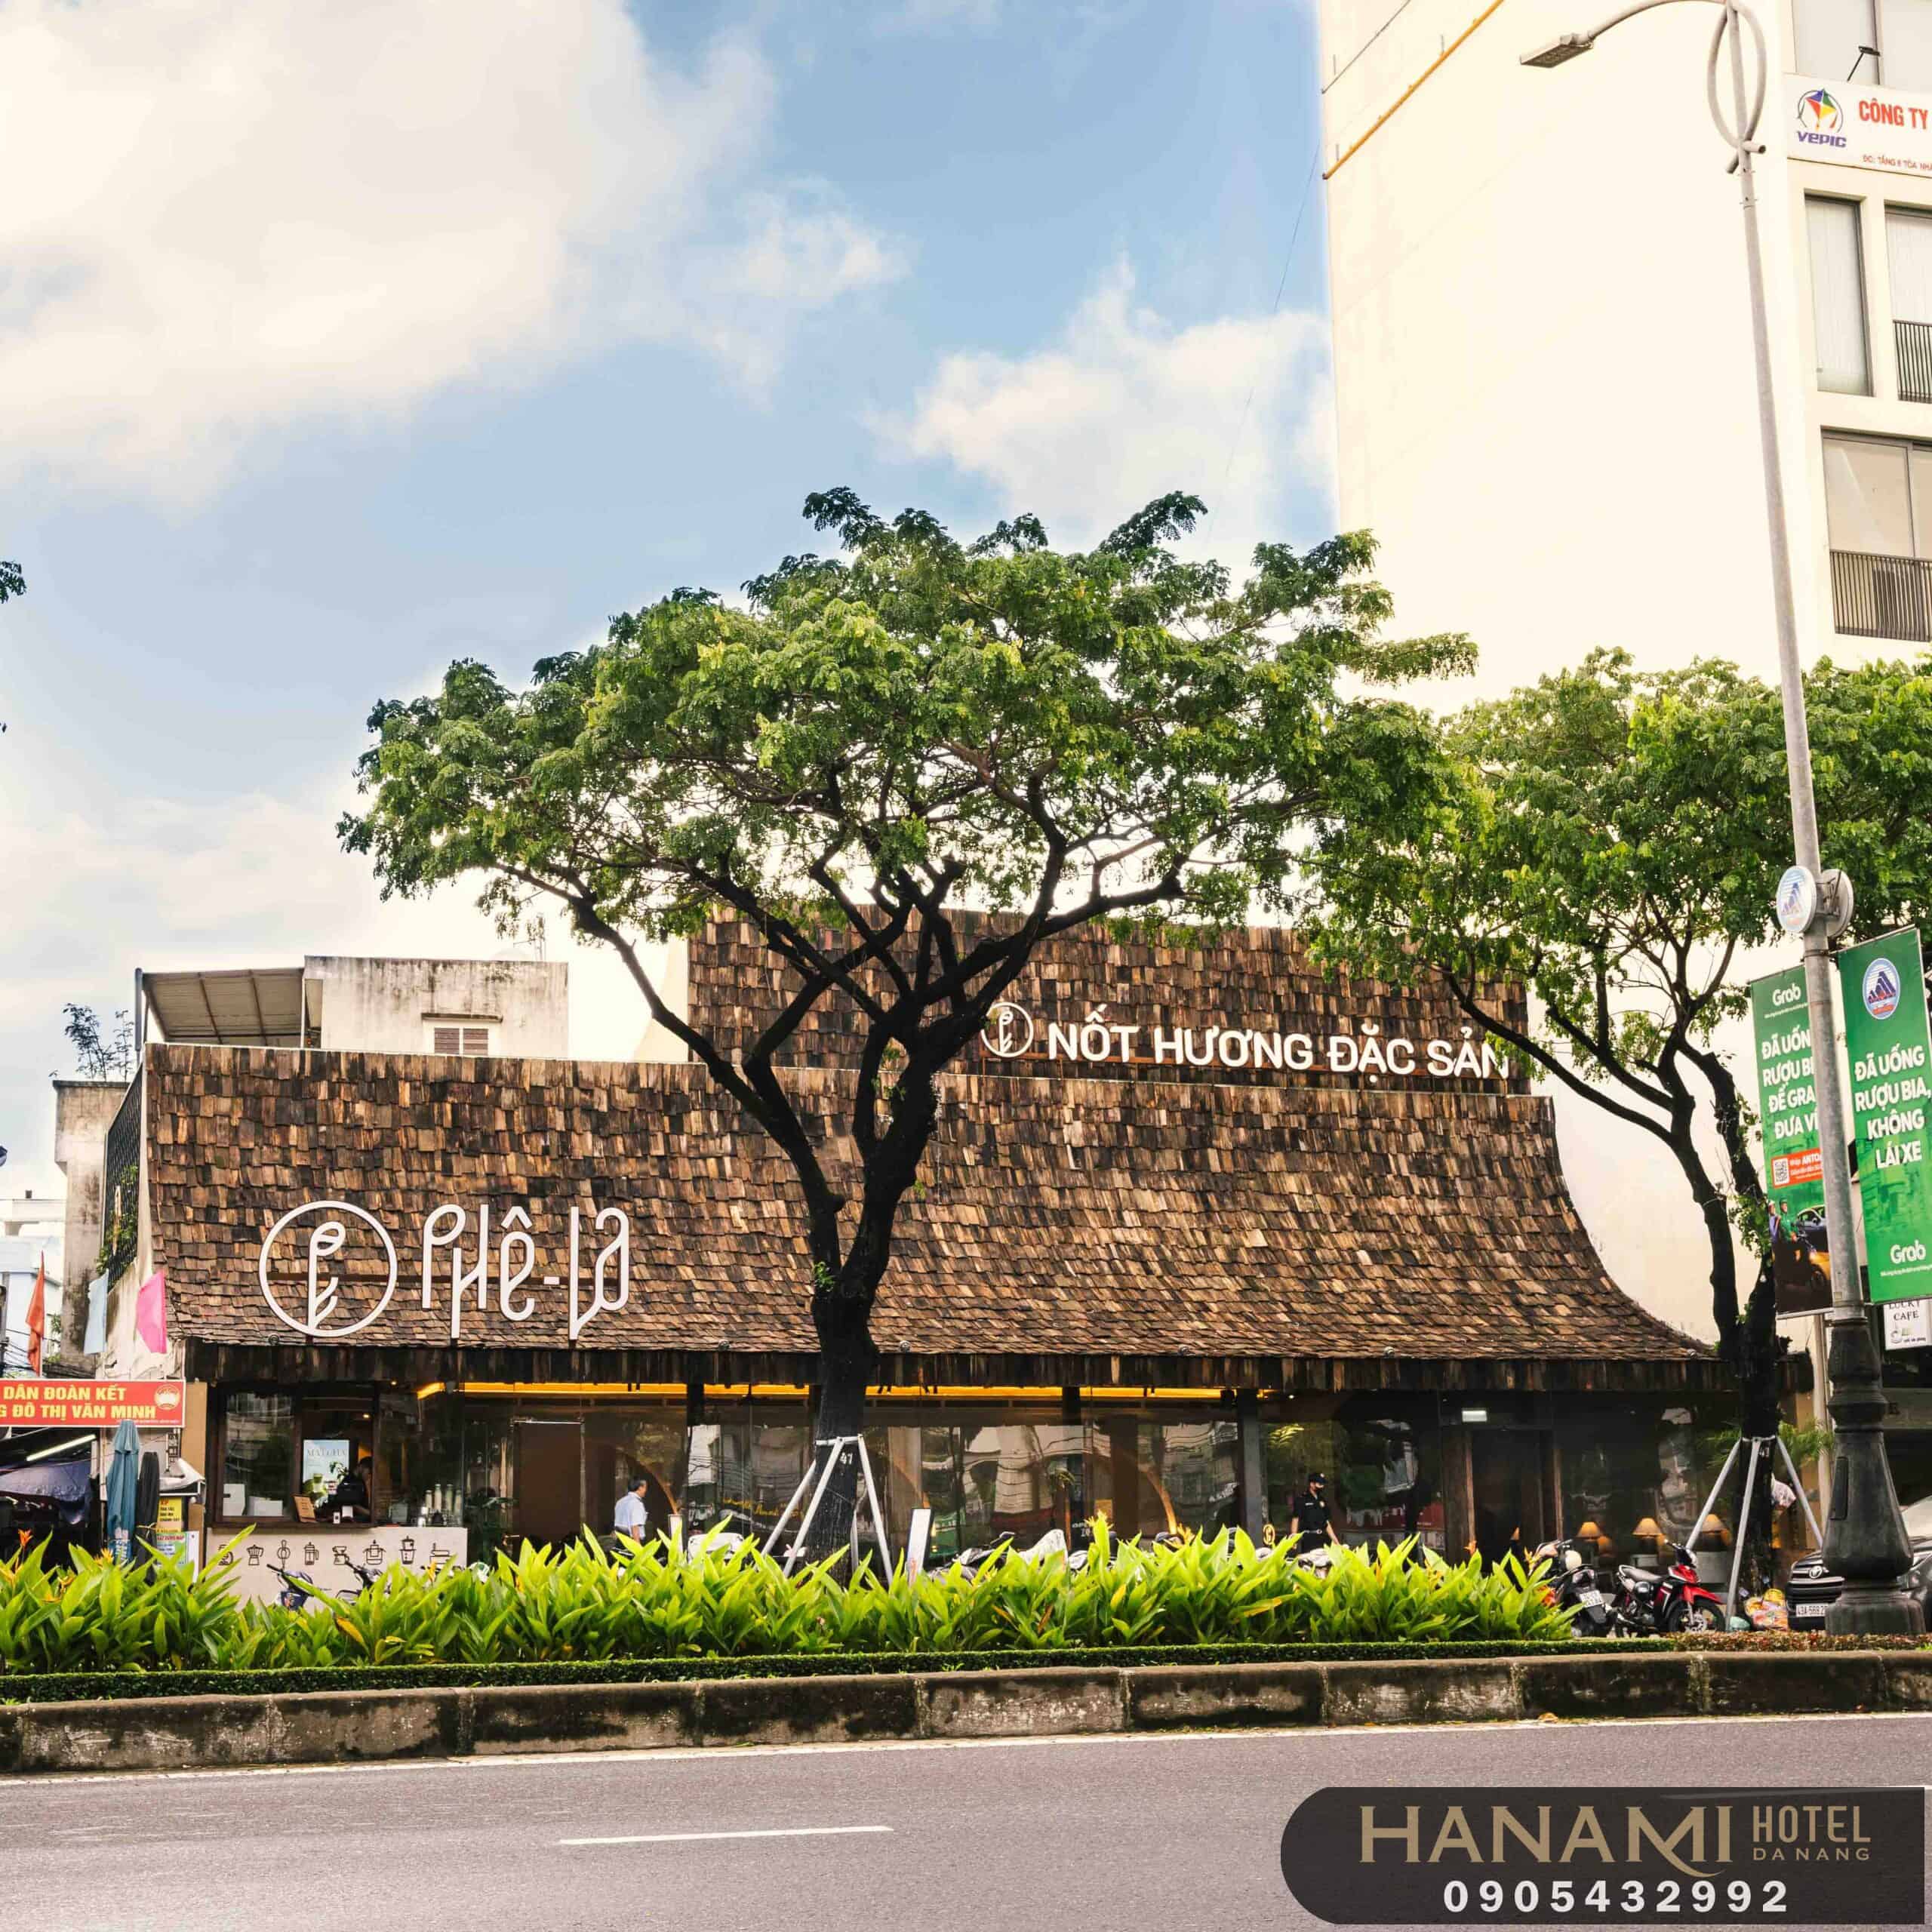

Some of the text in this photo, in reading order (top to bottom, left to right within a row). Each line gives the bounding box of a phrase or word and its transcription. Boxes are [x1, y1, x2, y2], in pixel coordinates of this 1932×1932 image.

[1859, 97, 1929, 130] CÔNG TY
[1772, 983, 1801, 1006] Grab
[1048, 1004, 1510, 1084] NỐT HƯƠNG ĐẶC SẢN
[1761, 1024, 1811, 1060] ĐÃ UỐN
[1762, 1060, 1801, 1088] RƯỢU
[1854, 1043, 1925, 1081] ĐÃ UỐNG
[1768, 1081, 1816, 1113] ĐỂ GRA
[1855, 1076, 1931, 1112] RƯỢU BIA,
[1774, 1114, 1804, 1140] ĐƯA
[1867, 1108, 1925, 1140] KHÔNG
[1876, 1140, 1922, 1169] LÁI XE
[1890, 1239, 1927, 1264] Grab
[1893, 1310, 1919, 1321] CAFE
[3, 1383, 127, 1401] DÂN ĐOÀN KẾT
[12, 1402, 35, 1418] ĐÔ
[41, 1404, 67, 1420] THỊ
[72, 1403, 106, 1419] VĂN
[111, 1404, 156, 1419] MINH
